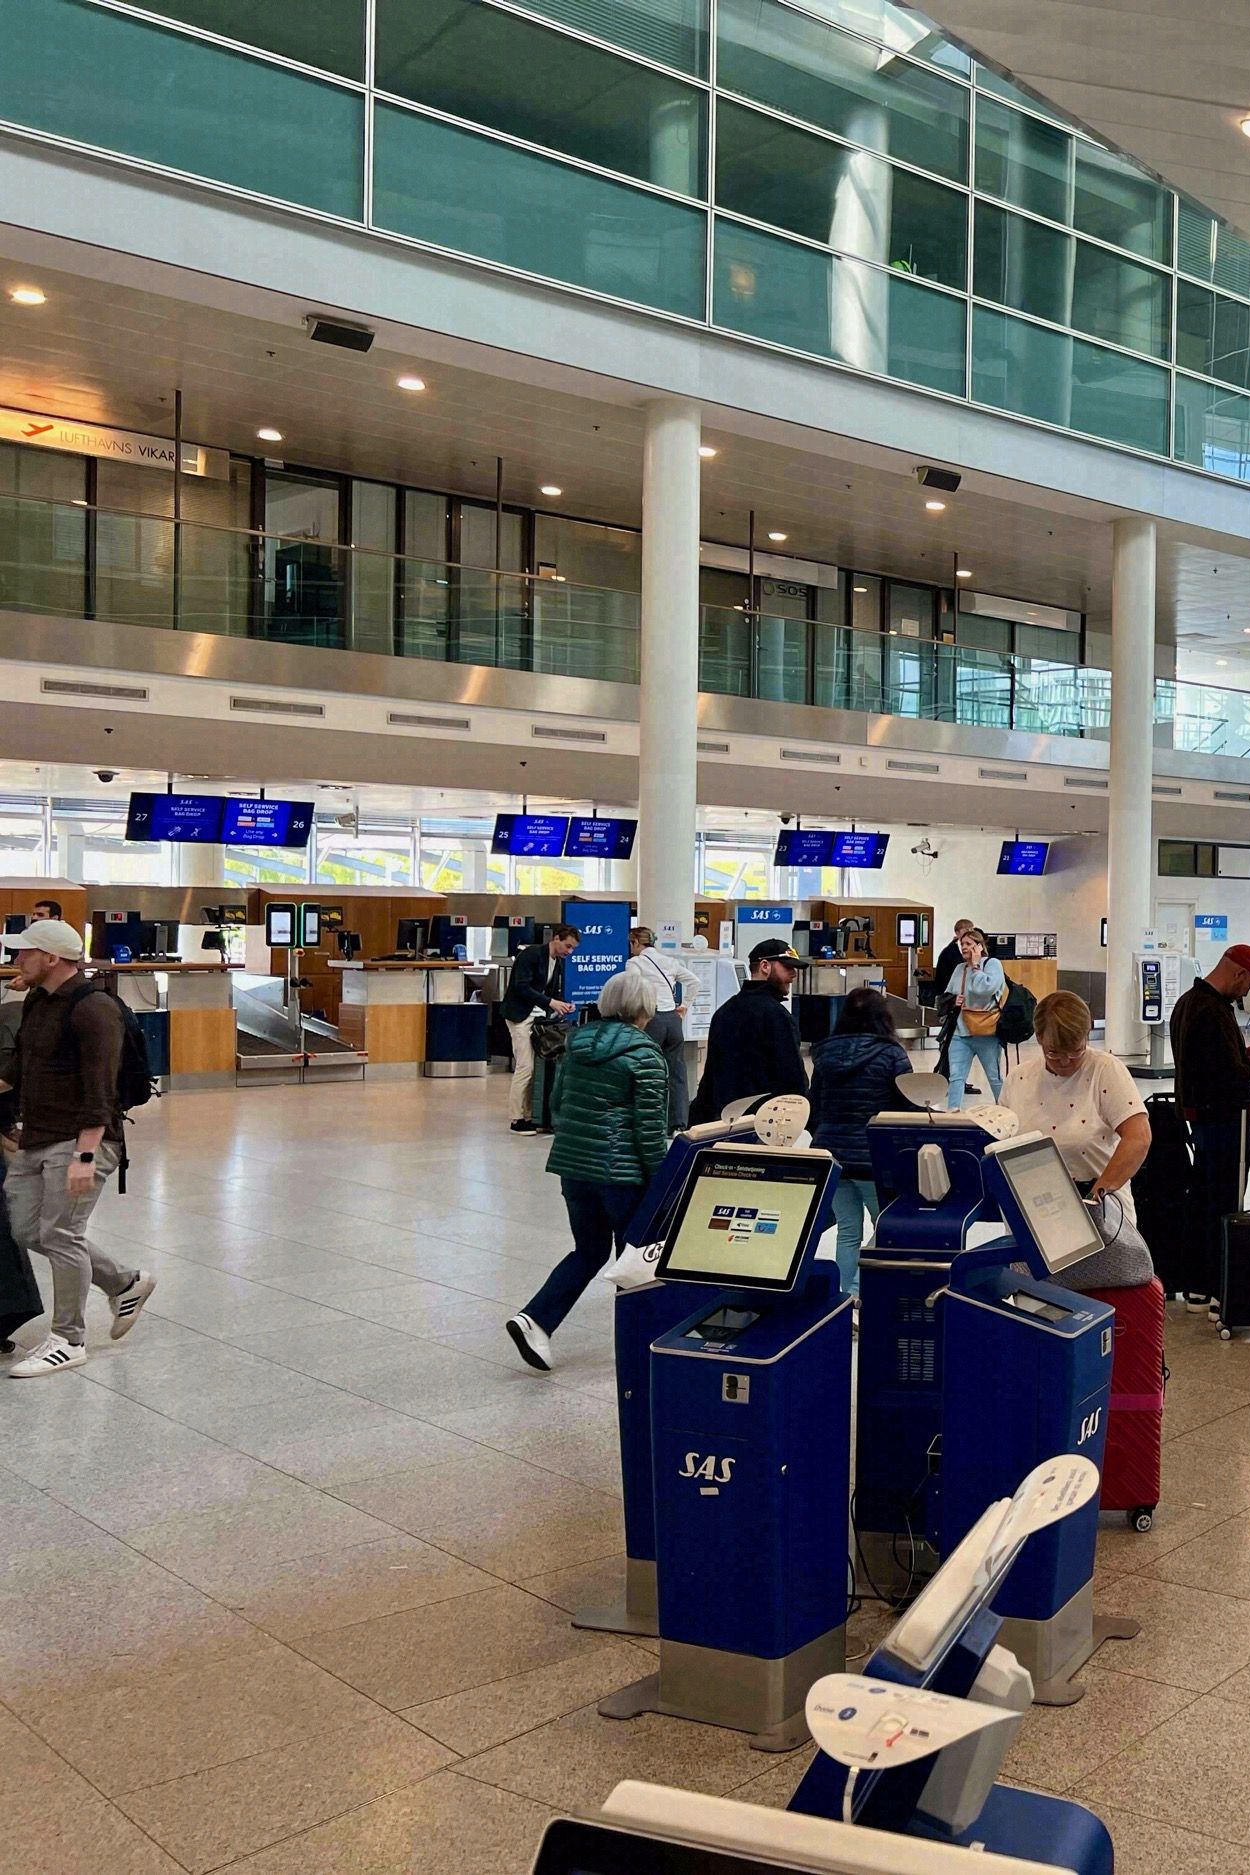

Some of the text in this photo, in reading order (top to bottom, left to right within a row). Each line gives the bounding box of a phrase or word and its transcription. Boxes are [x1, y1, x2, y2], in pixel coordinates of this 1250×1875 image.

[60, 431, 175, 463] LUFTHAVNS VIKAR
[777, 584, 808, 598] SOS
[293, 821, 305, 829] 26
[751, 910, 770, 920] SAS
[583, 925, 602, 935] SAS
[572, 955, 623, 963] SELF SERVICE
[578, 964, 617, 972] BAG DROP
[1077, 1407, 1102, 1445] SAS
[678, 1452, 736, 1483] SAS
